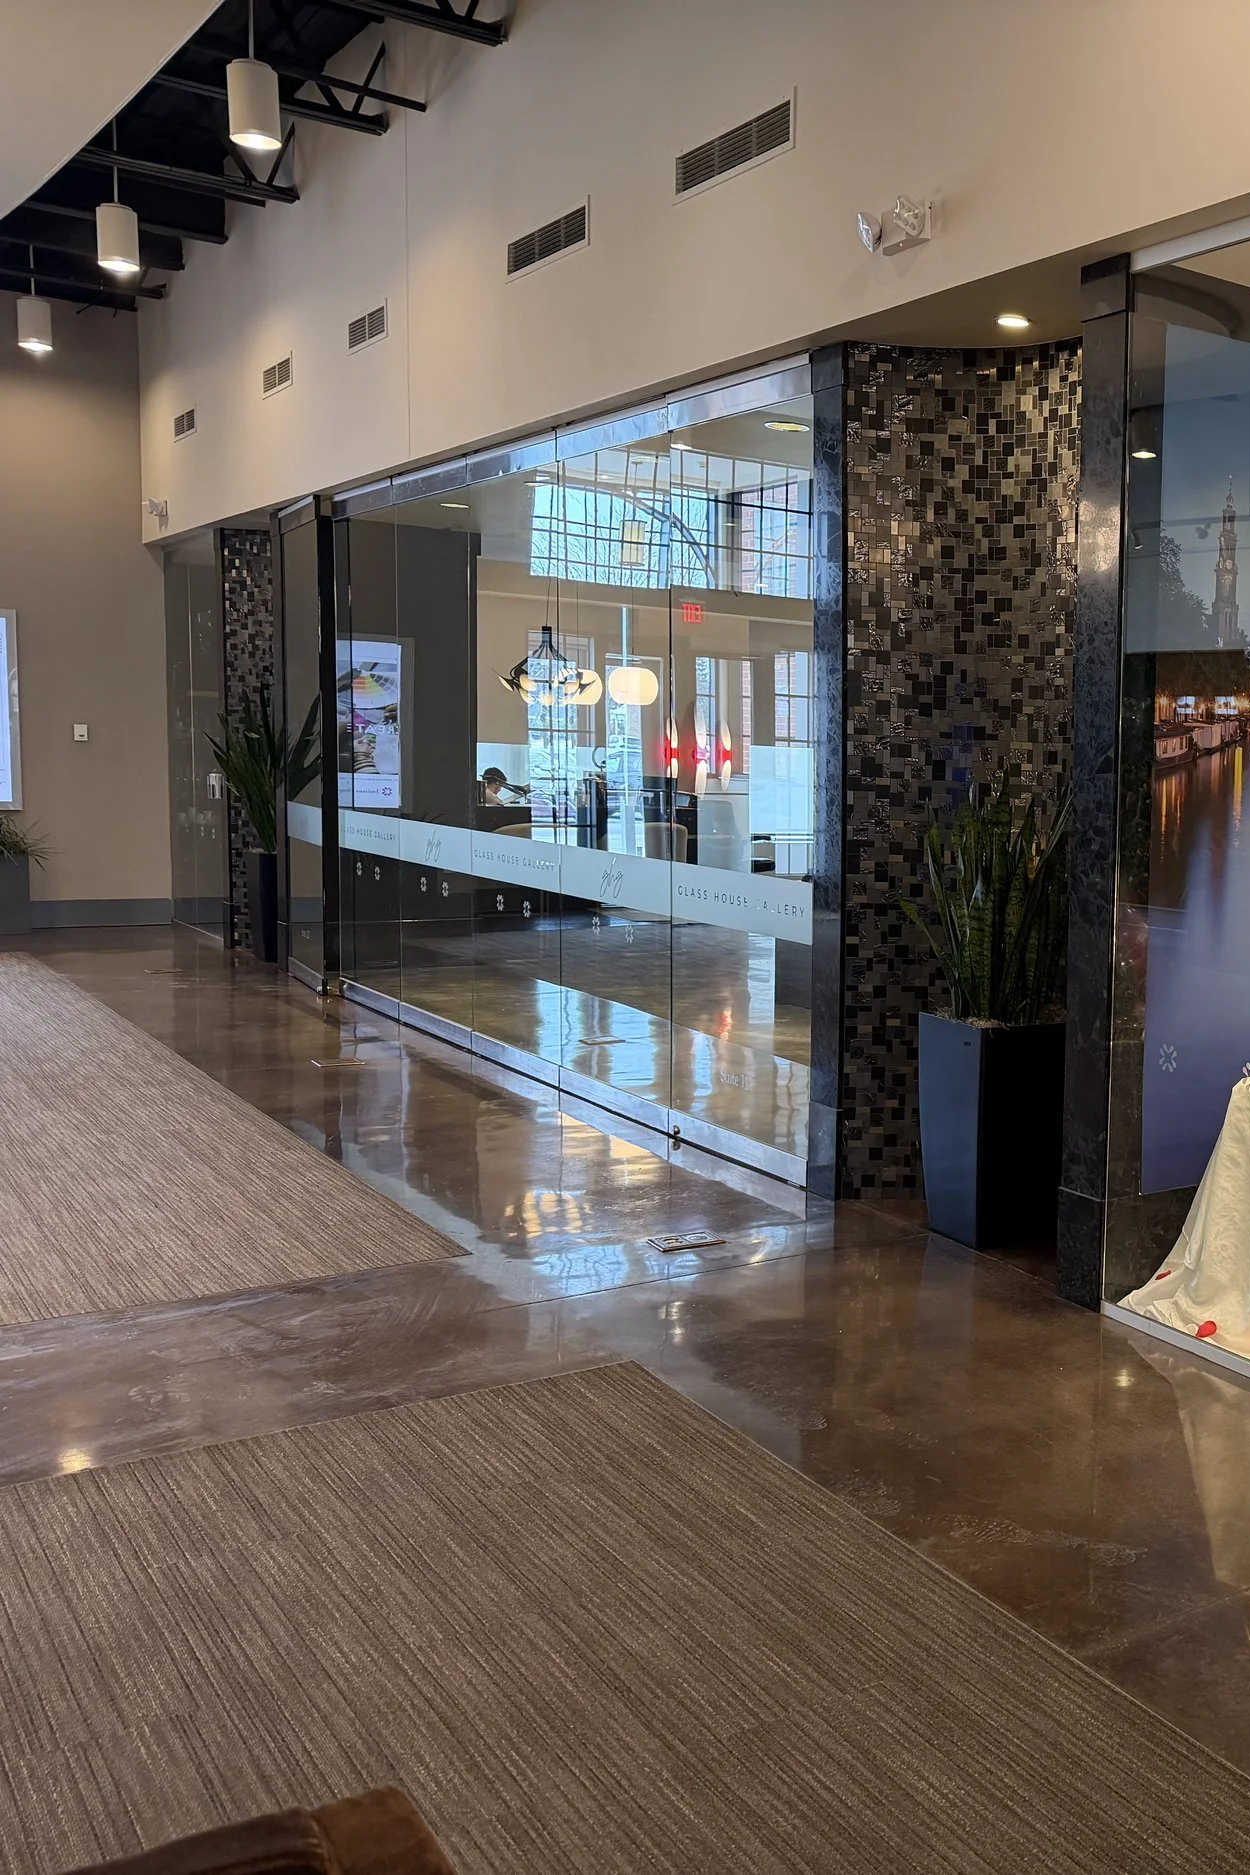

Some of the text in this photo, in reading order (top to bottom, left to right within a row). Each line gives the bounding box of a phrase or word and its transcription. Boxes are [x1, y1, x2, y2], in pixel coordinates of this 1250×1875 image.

[474, 849, 494, 860] GLASS
[497, 854, 519, 866] HOUSE
[677, 885, 708, 900] GLASS
[714, 892, 748, 907] HOUSE
